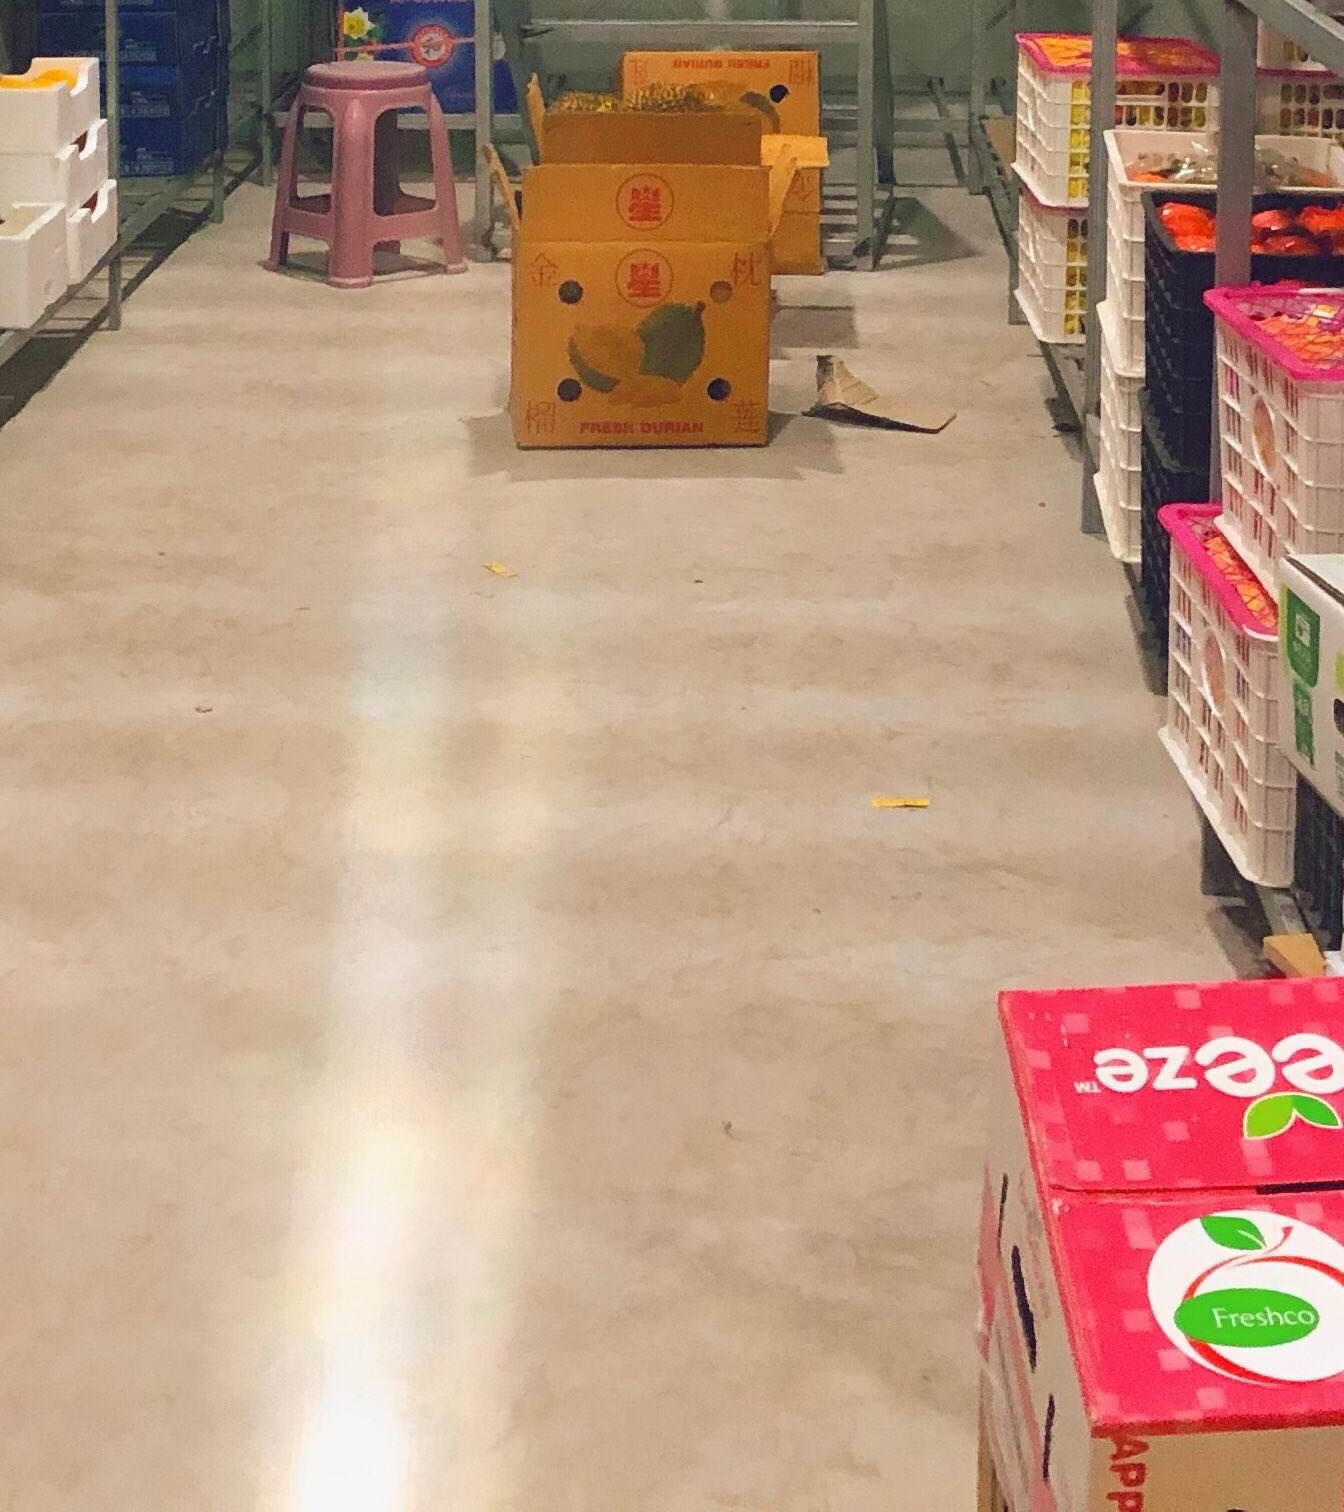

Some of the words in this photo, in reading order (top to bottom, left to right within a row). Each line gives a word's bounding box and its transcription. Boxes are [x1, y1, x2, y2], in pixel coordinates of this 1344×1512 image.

[579, 421, 635, 435] FRESH
[640, 421, 705, 435] DURIAN
[1212, 1306, 1315, 1329] Freshco
[1108, 1435, 1150, 1512] APP
